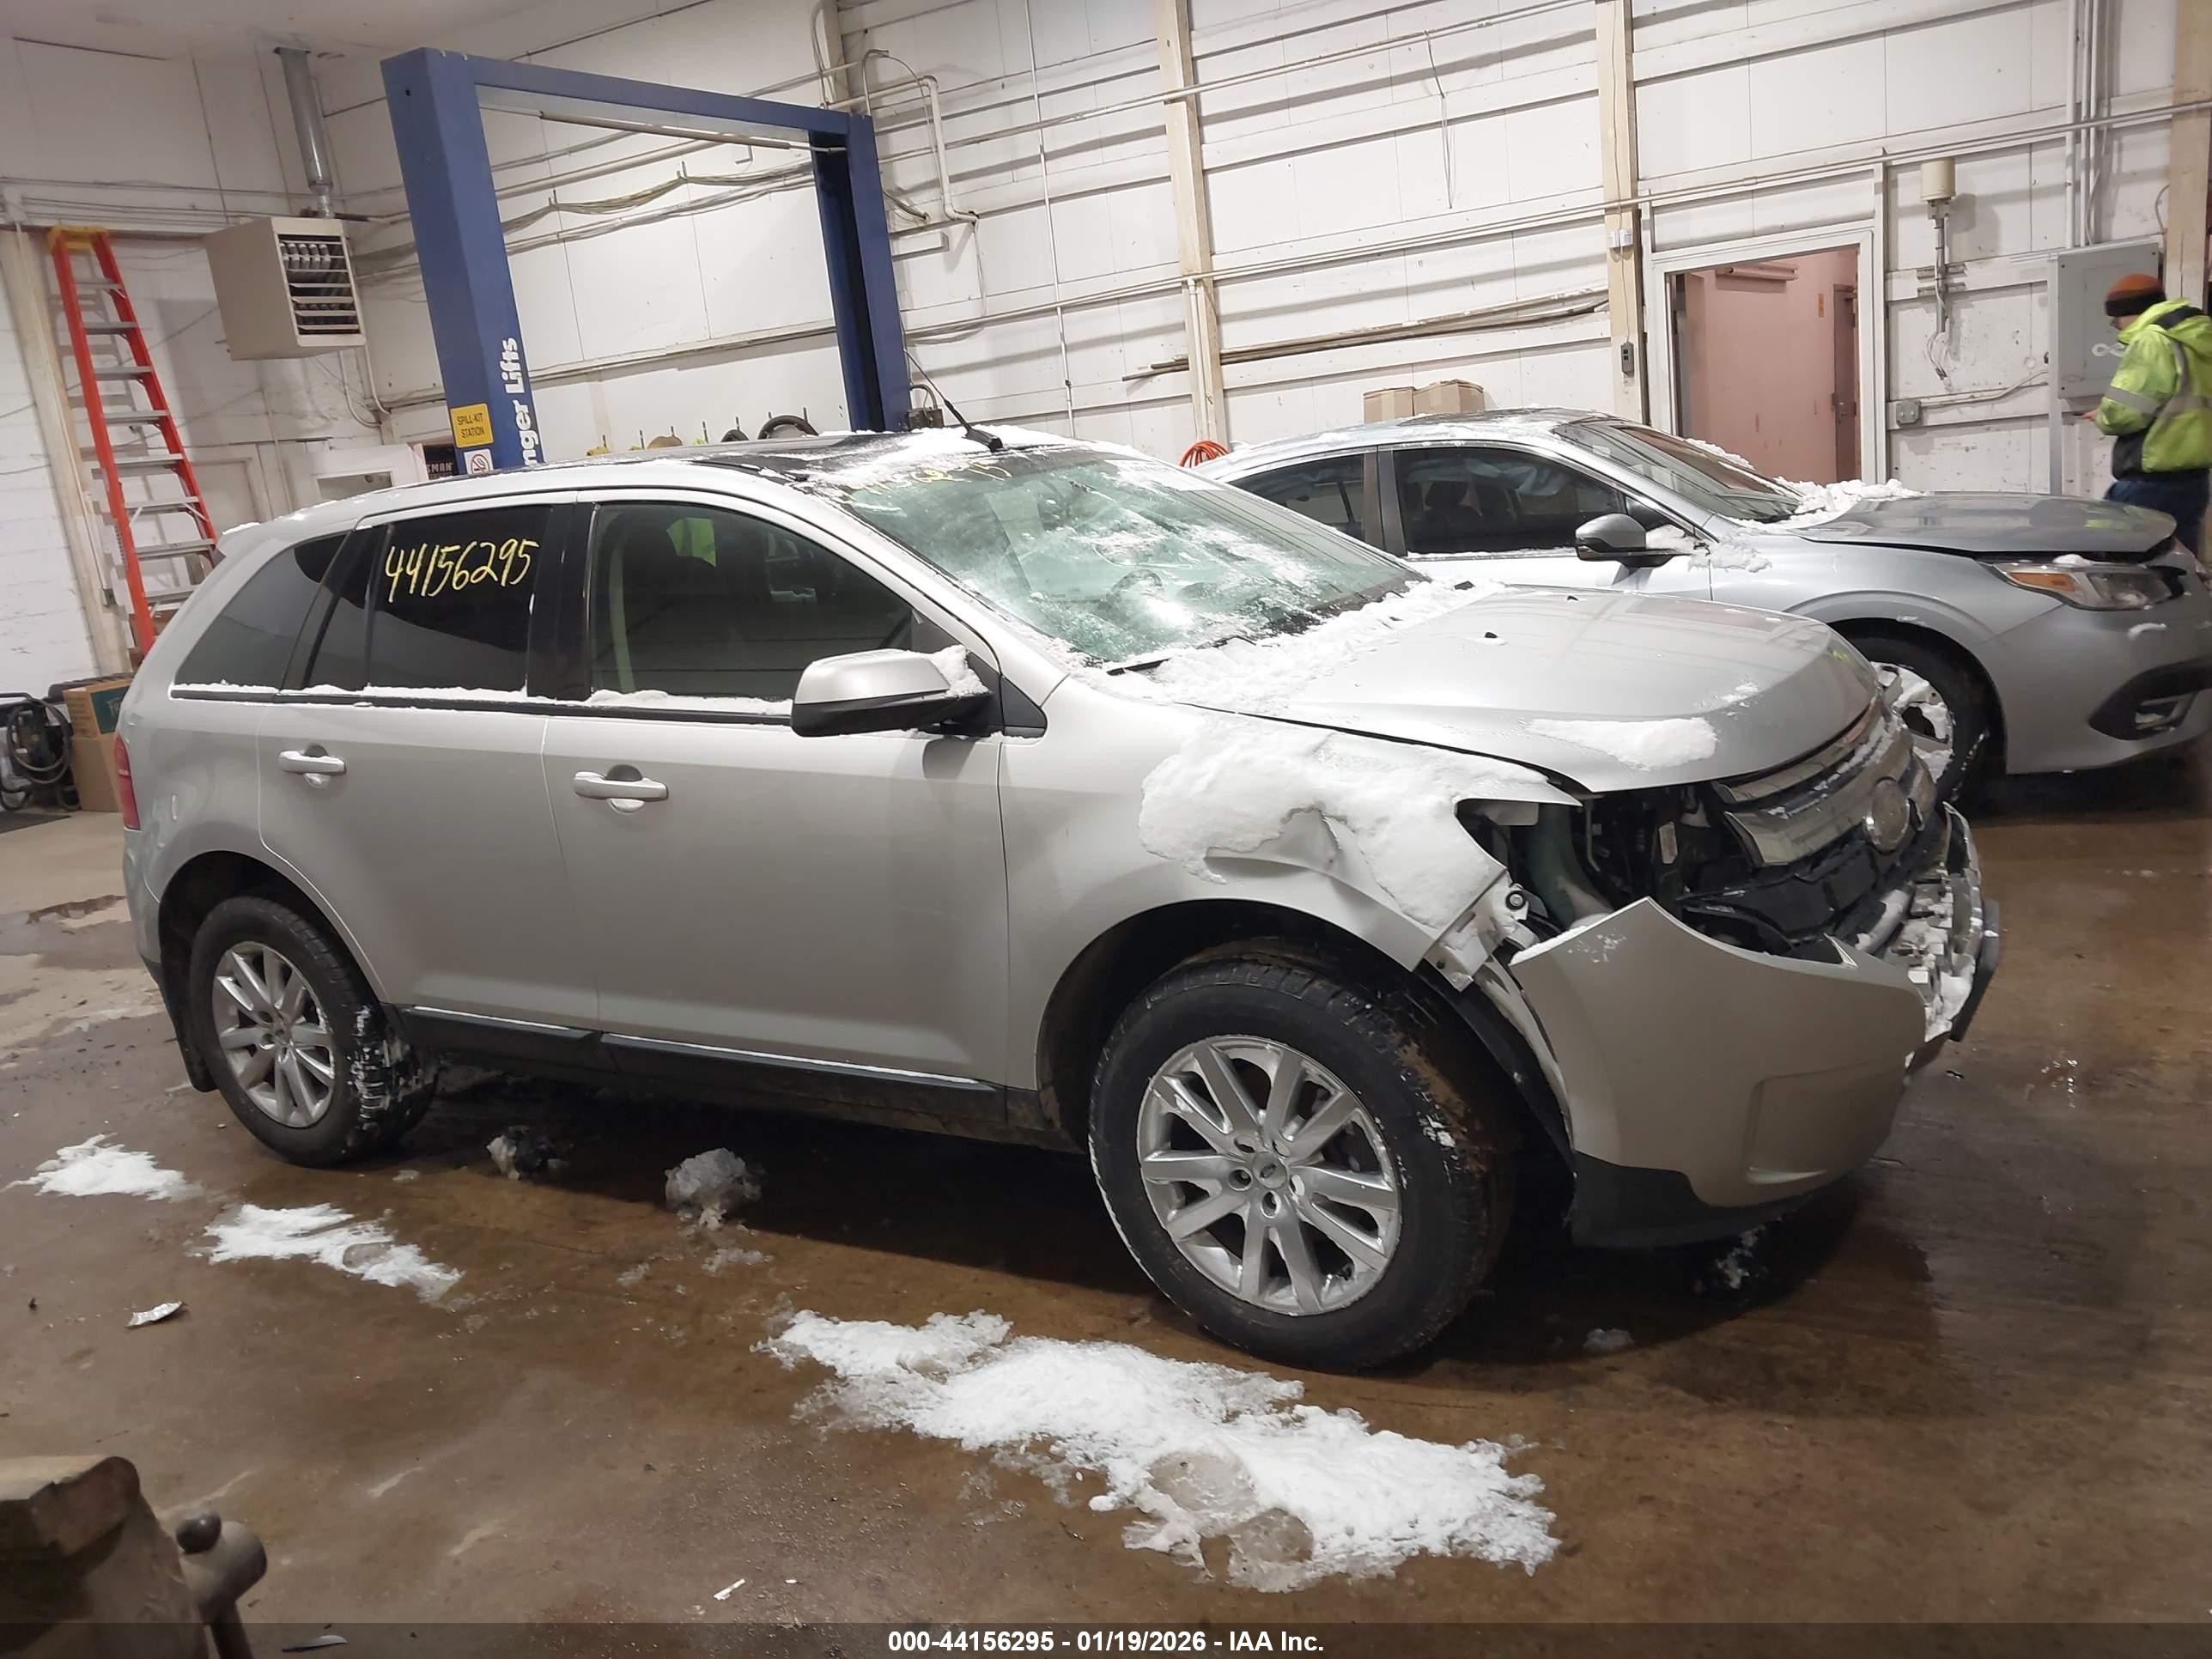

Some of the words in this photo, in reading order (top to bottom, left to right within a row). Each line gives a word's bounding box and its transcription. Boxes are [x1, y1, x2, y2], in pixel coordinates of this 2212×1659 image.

[500, 337, 525, 393] Lifts
[460, 426, 485, 438] STATION
[385, 538, 540, 603] 44156295
